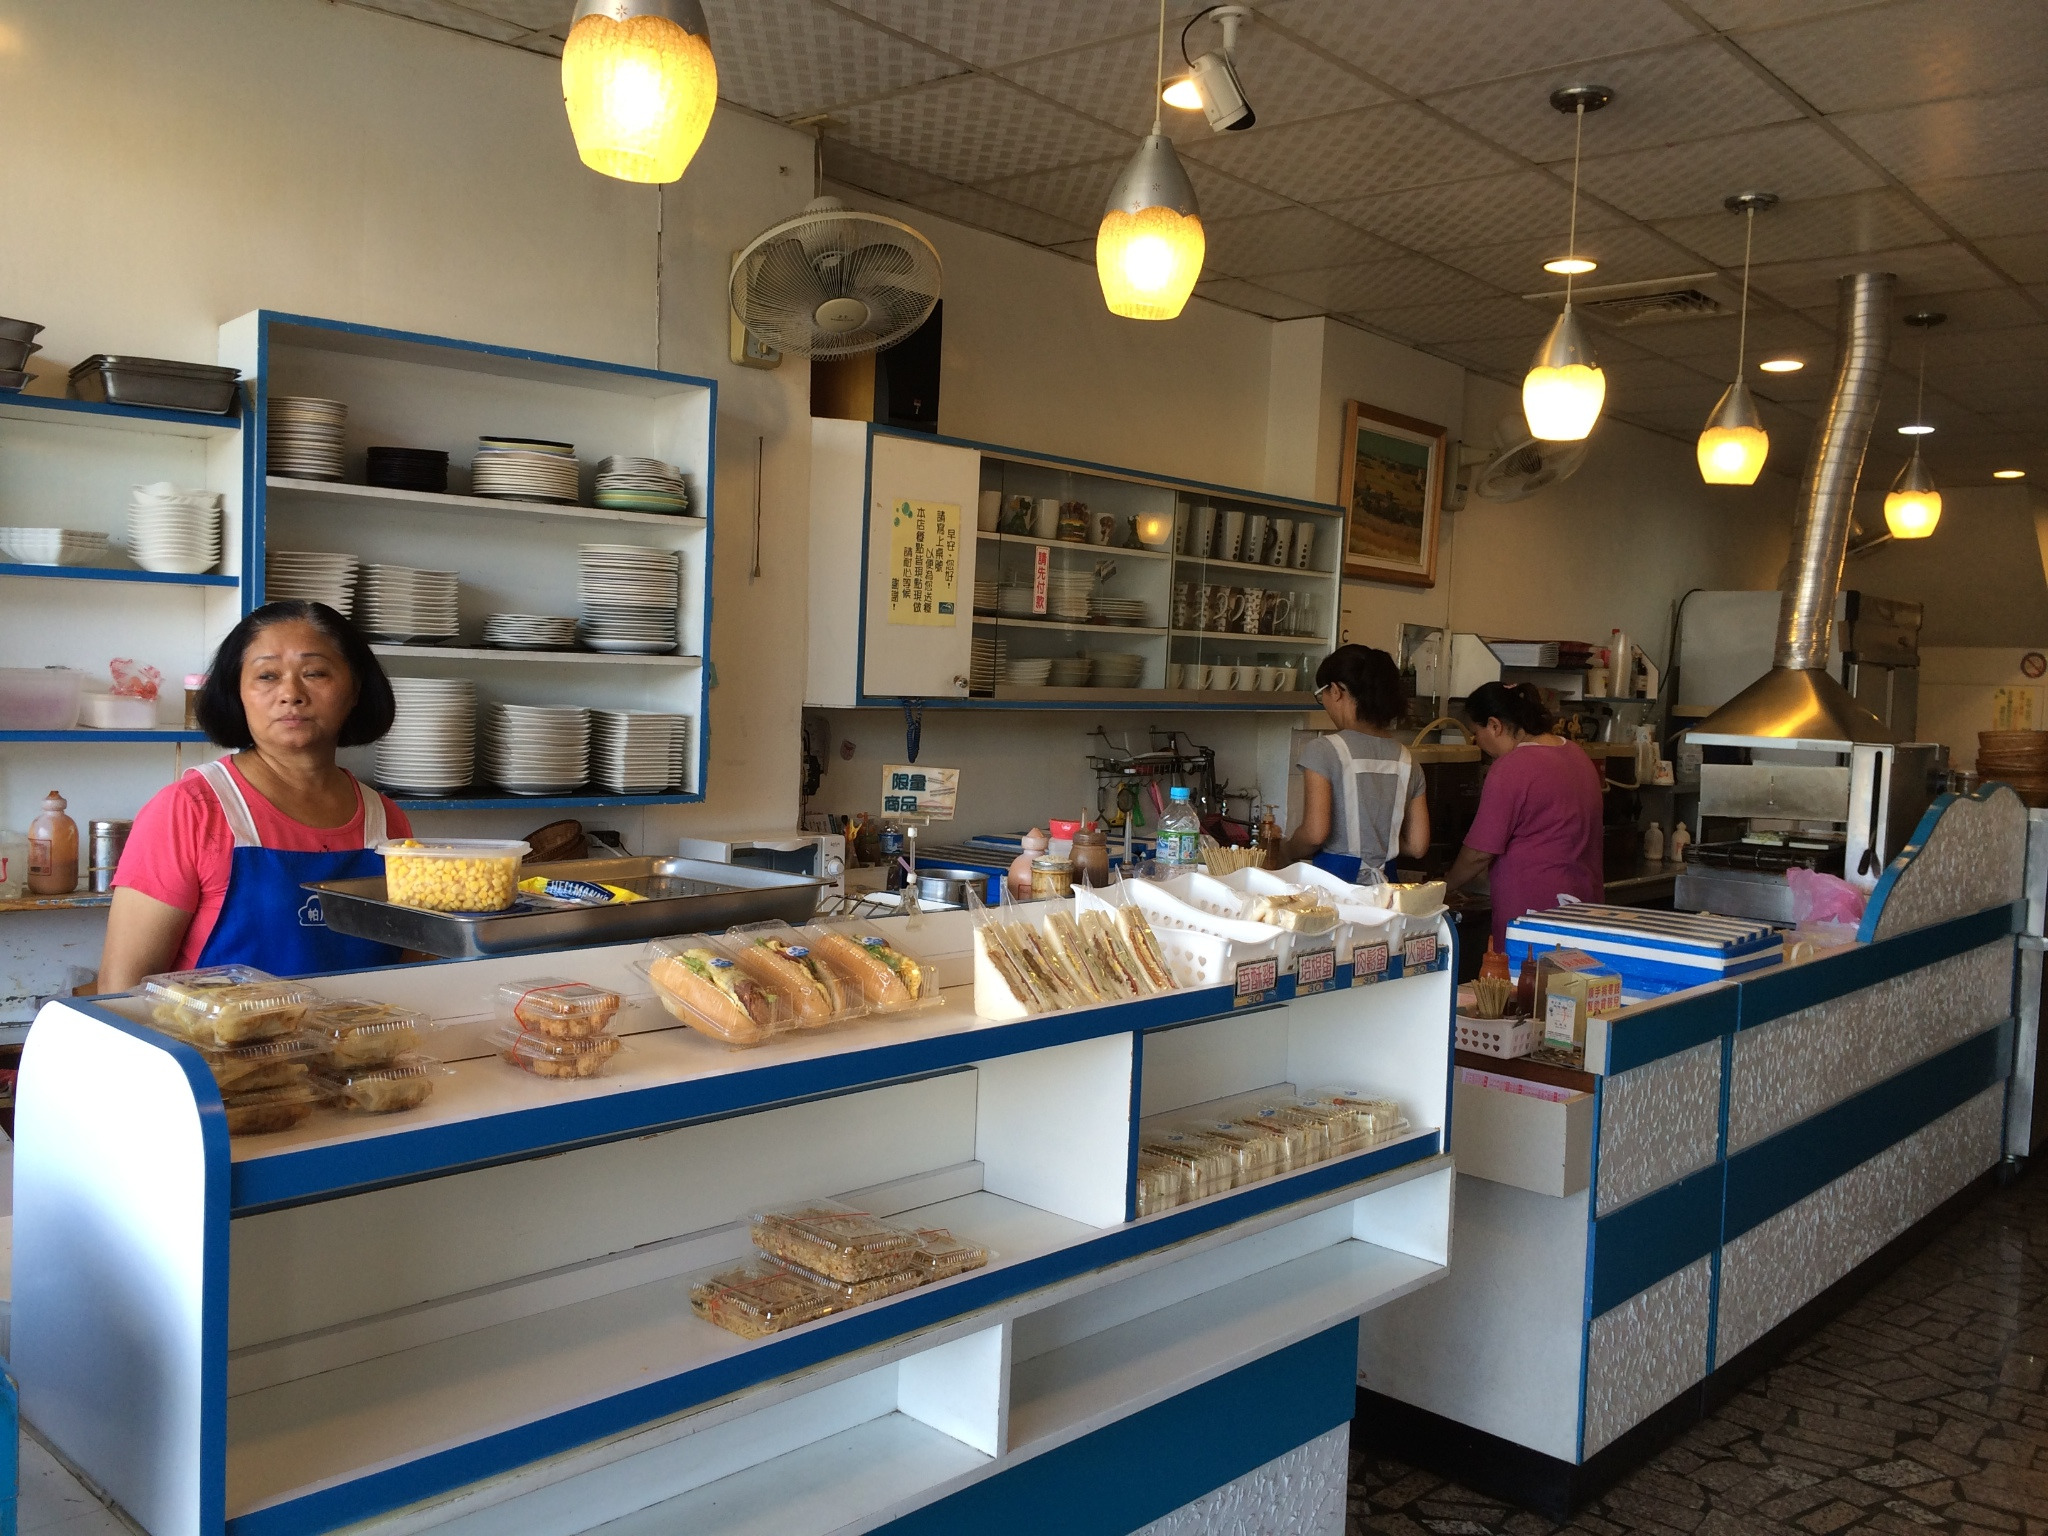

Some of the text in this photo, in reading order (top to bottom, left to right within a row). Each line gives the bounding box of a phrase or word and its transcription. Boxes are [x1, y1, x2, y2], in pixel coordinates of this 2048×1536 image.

[902, 546, 912, 599] 請耐心等候
[1035, 551, 1047, 609] 請先付款
[892, 773, 926, 791] 限量
[884, 795, 917, 812] 商品
[1406, 938, 1435, 964] 火腿蛋
[1301, 953, 1332, 980] 培根蛋
[1413, 965, 1426, 975] 30
[1239, 963, 1275, 992] 香酥雞
[1363, 975, 1376, 985] 30
[1307, 984, 1322, 993] 30
[1246, 992, 1262, 1004] 30
